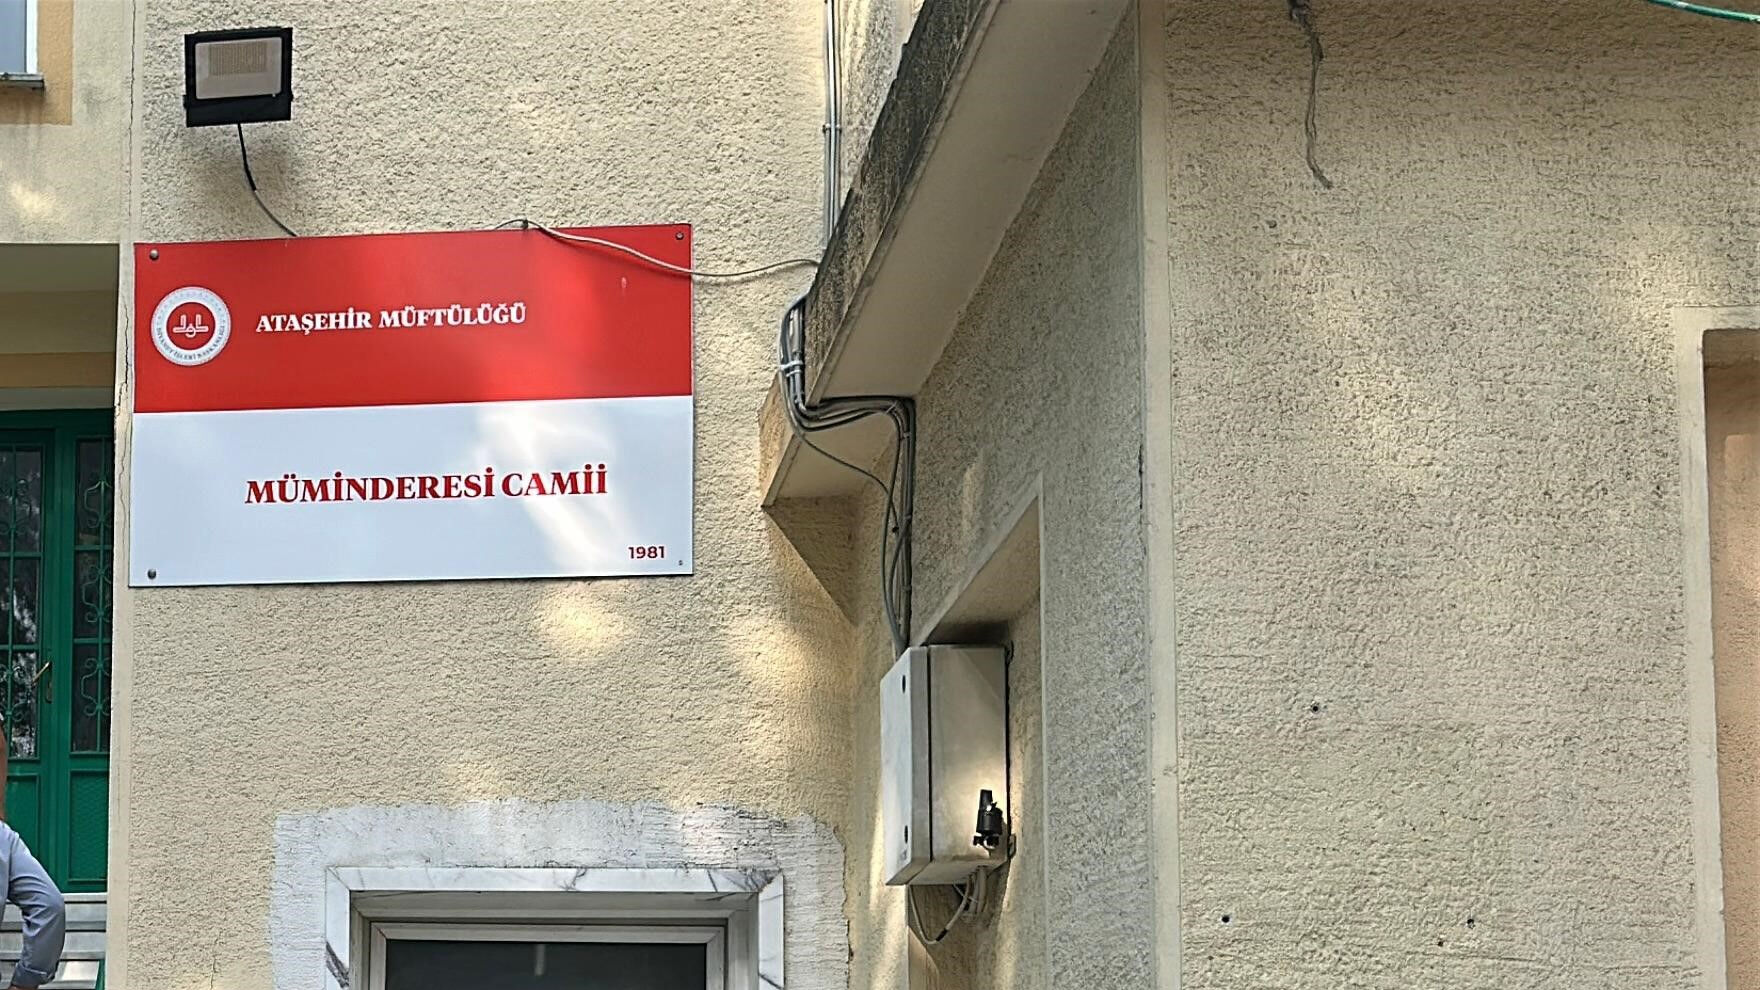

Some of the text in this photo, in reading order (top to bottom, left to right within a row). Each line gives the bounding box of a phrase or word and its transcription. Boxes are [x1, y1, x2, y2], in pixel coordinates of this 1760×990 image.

[256, 302, 526, 335] ATAŞEHİR MÜFTÜLÜĞÜ
[245, 464, 608, 503] MÜMİNDERESİ CAMİİ
[628, 546, 665, 559] 1981
